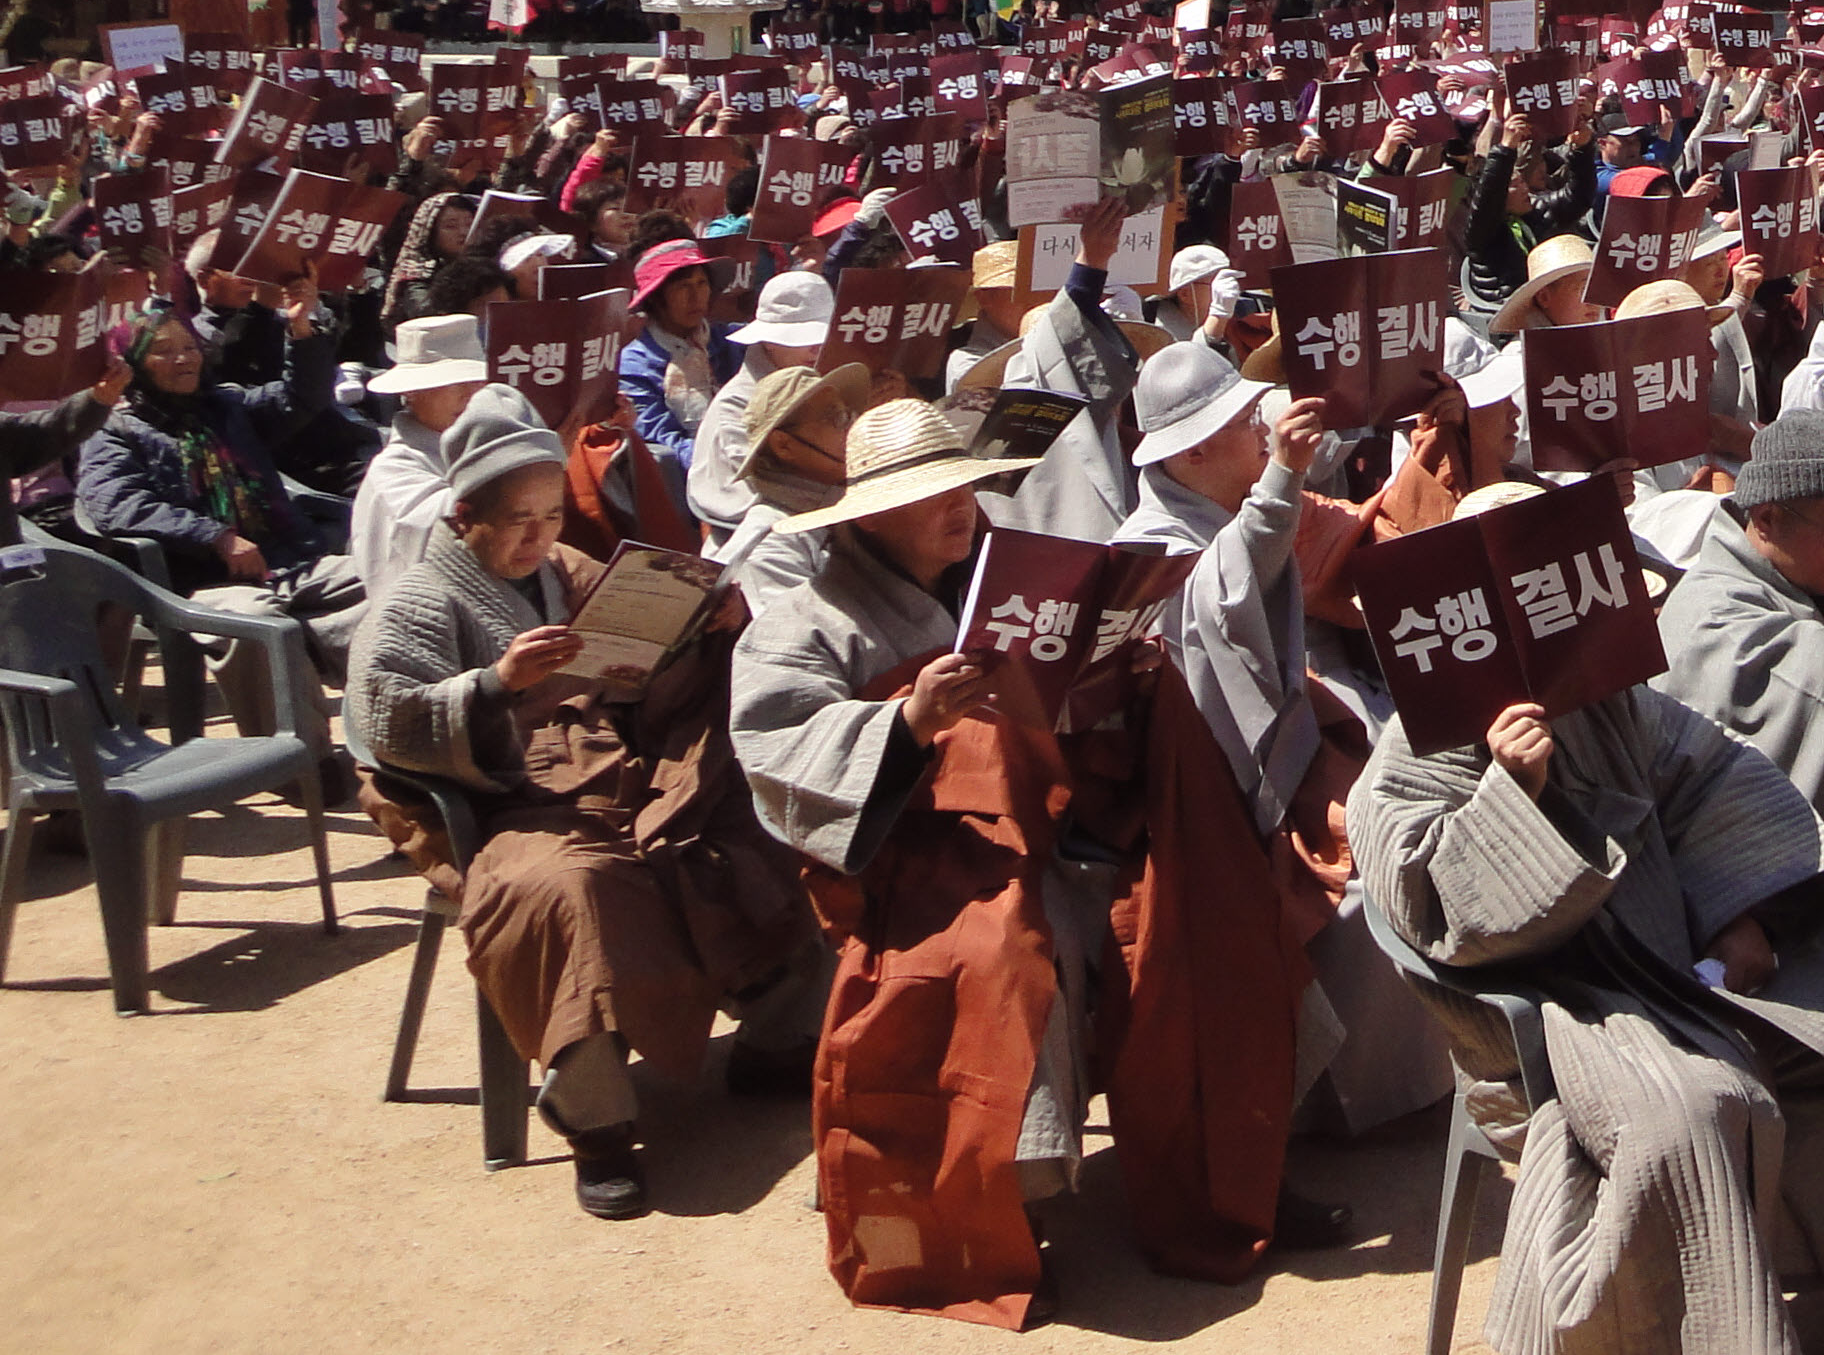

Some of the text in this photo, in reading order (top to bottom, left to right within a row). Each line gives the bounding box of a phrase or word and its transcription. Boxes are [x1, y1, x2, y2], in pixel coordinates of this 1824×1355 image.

[1400, 10, 1446, 29] 수행 결사
[1459, 5, 1479, 20] 결사
[794, 32, 818, 48] 결사
[937, 33, 957, 47] 수행
[1246, 23, 1268, 38] 결사
[1328, 16, 1384, 40] 수행 결사
[1720, 28, 1772, 48] 수행 결사
[189, 50, 252, 69] 수행 결사
[359, 43, 419, 64] 수행 결사
[667, 44, 686, 59] 수행
[1024, 38, 1068, 54] 수행 결사
[1086, 41, 1111, 60] 수행
[1184, 41, 1208, 57] 수행
[1279, 39, 1309, 59] 수행
[836, 60, 859, 79] 수행
[148, 84, 217, 114] 수행 결사
[437, 84, 517, 114] 수행 결사
[730, 84, 797, 114] 수행 결사
[938, 74, 979, 100] 수행
[1515, 83, 1552, 112] 수행
[1623, 74, 1682, 103] 수행 결사
[607, 100, 639, 123] 수행
[908, 96, 935, 116] 수행
[1174, 102, 1206, 129] 수행
[1244, 100, 1276, 125] 수행
[1324, 99, 1393, 131] 수행 결사
[1394, 92, 1437, 122] 수행
[25, 118, 62, 142] 결사
[247, 108, 287, 145] 수행
[306, 117, 393, 149] 수행 결사
[881, 138, 961, 175] 수행 결사
[637, 160, 725, 188] 수행 결사
[768, 169, 814, 207] 수행
[103, 202, 143, 236] 수행
[908, 206, 960, 249] 수행
[1418, 197, 1447, 237] 결사
[1751, 202, 1794, 241] 수행
[275, 209, 381, 256] 수행 결사
[1042, 229, 1155, 255] 다시 서자
[1237, 214, 1279, 251] 수행
[1608, 228, 1699, 273] 수행 결사
[837, 301, 951, 345] 수행 결사
[1295, 299, 1439, 371] 수행 결사
[497, 331, 619, 388] 수행 결사
[1541, 354, 1699, 422] 수행 결사
[1389, 542, 1629, 673] 수행 결사
[985, 593, 1080, 663] 수행
